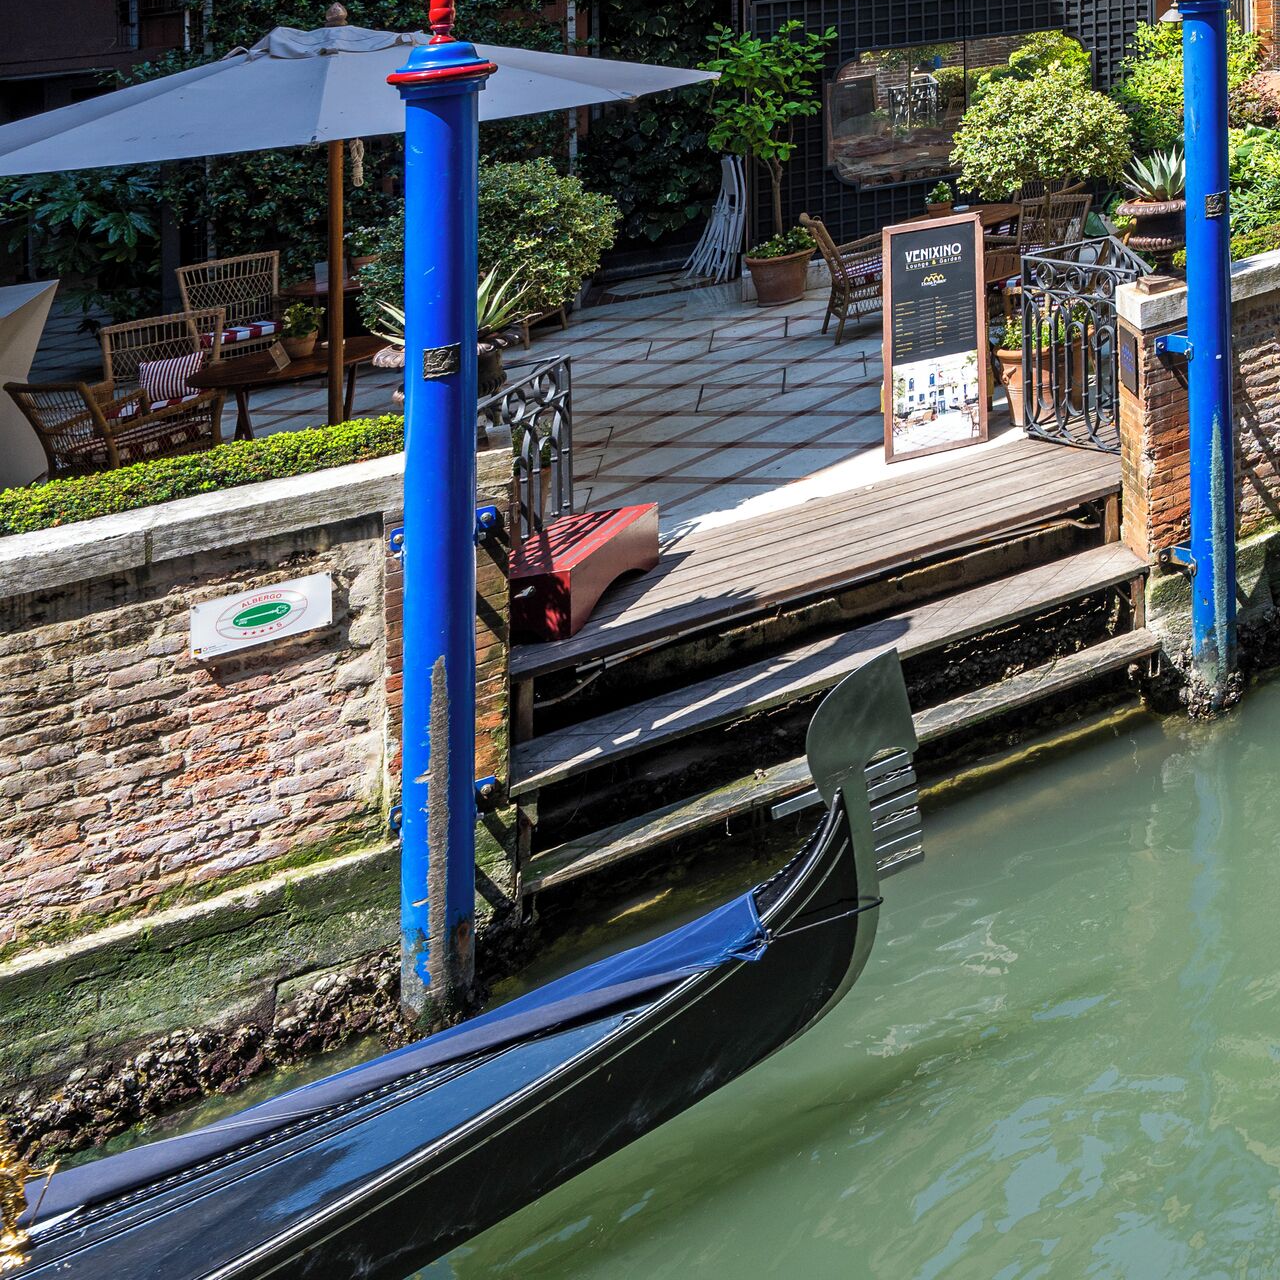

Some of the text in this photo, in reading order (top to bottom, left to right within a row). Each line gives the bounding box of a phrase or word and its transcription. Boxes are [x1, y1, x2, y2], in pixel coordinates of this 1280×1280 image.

[905, 243, 962, 263] VENIXINO
[905, 261, 929, 270] Lounge
[939, 256, 962, 264] Garden
[241, 593, 282, 608] ALBERGO
